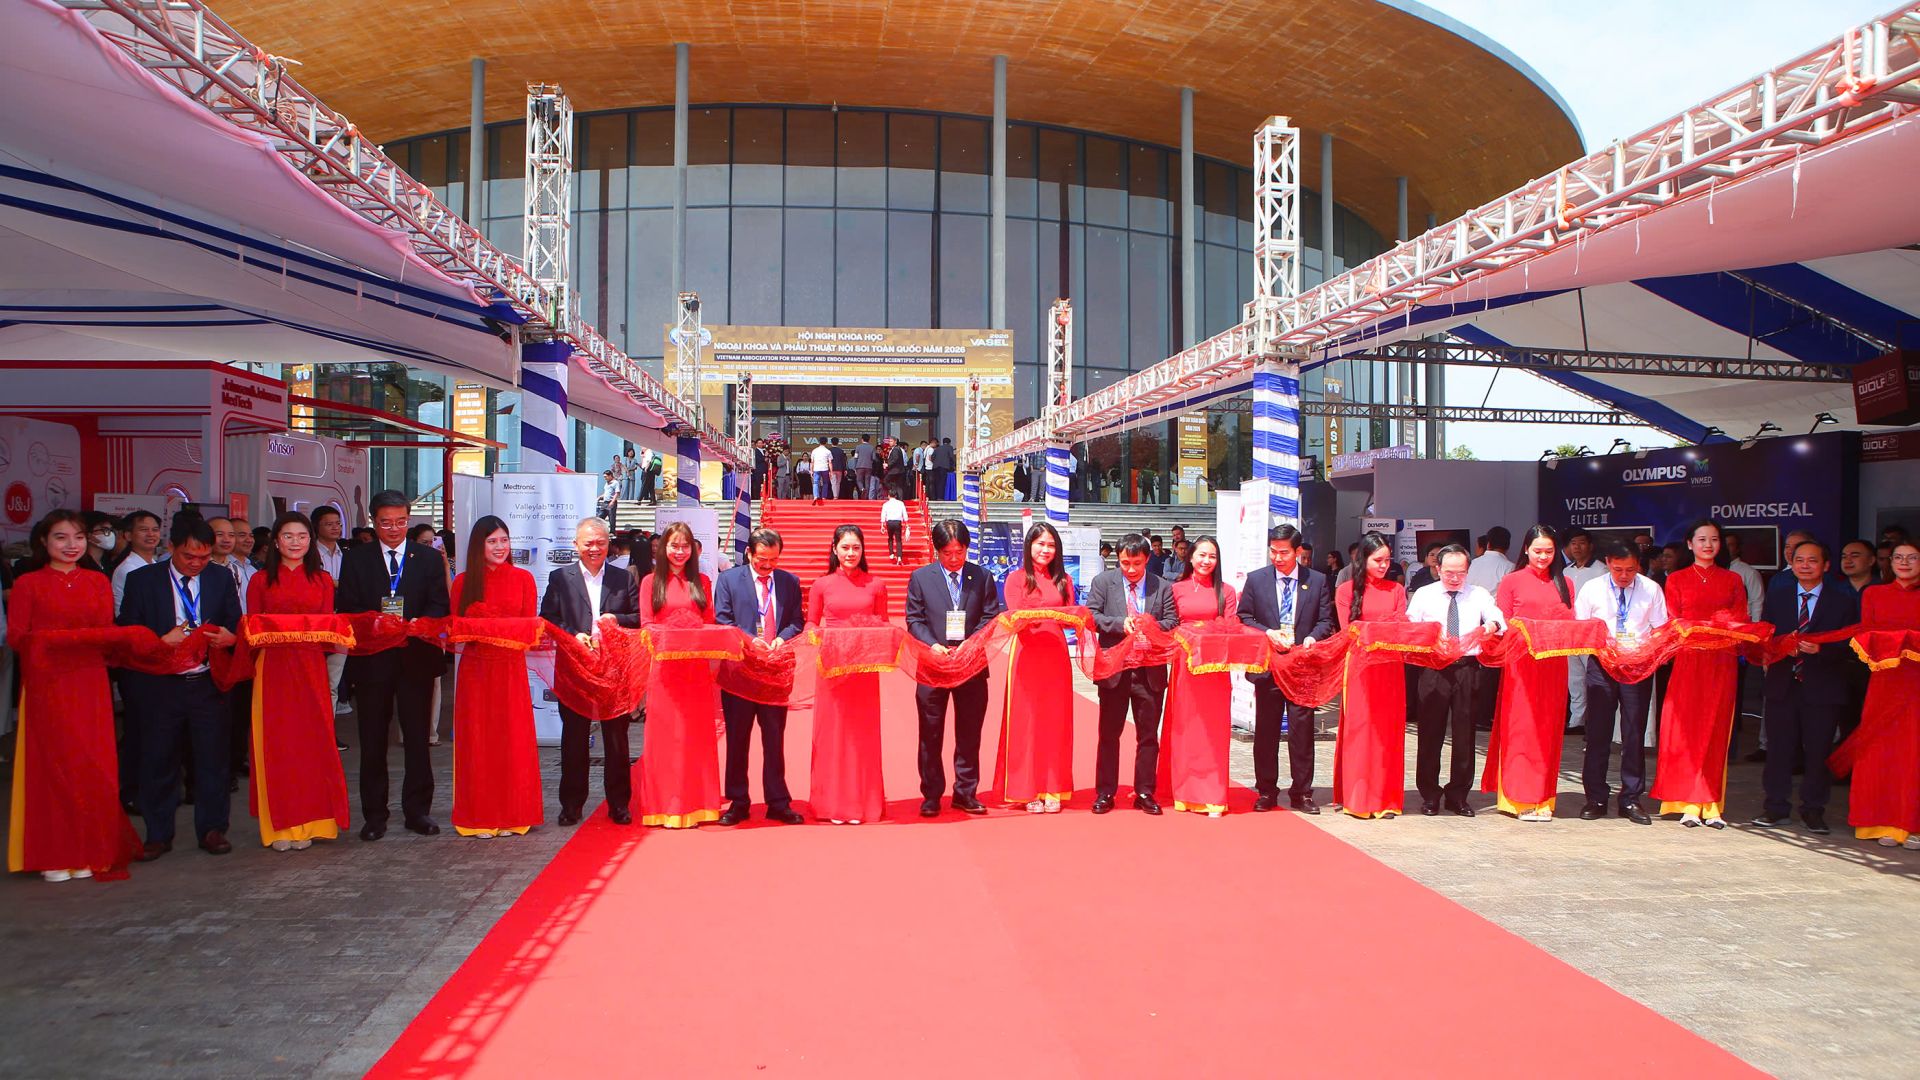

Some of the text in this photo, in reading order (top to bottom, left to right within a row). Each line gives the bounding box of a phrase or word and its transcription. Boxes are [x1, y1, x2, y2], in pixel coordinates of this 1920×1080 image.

[798, 331, 883, 342] HỘI NGHỊ KHOA HỌC
[713, 343, 741, 352] NGOẠI
[871, 344, 894, 353] TOÀN
[970, 339, 1008, 347] VASEL
[1858, 378, 1886, 395] WOLF
[221, 392, 252, 410] MedTech
[1863, 440, 1887, 450] WOLF
[1623, 465, 1687, 482] OLYMPUS
[1691, 476, 1712, 485] VNMED
[7, 496, 31, 512] J&J
[1565, 496, 1616, 511] VISERA
[509, 512, 531, 520] family
[1711, 502, 1814, 519] POWERSEAL
[1571, 514, 1598, 525] ELITE
